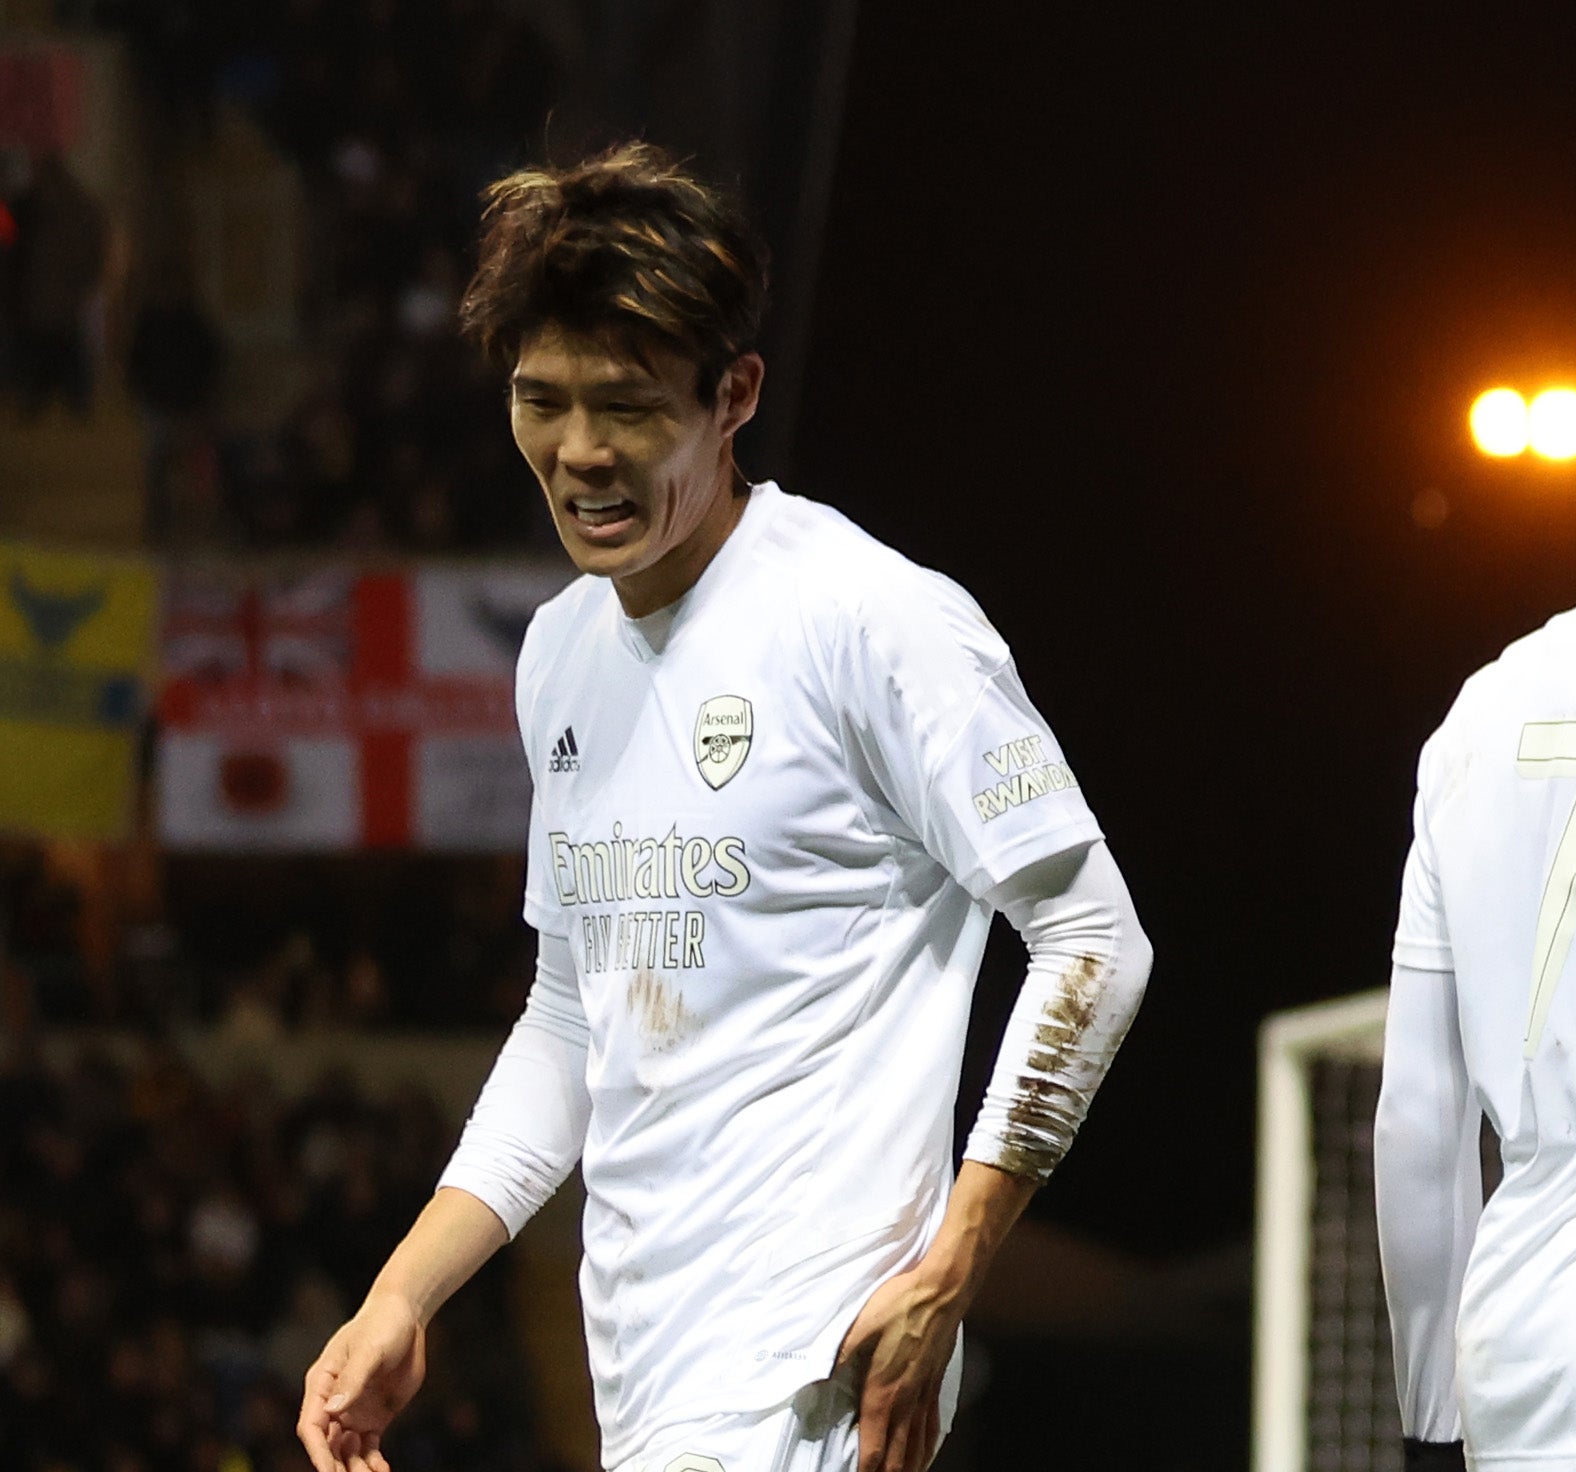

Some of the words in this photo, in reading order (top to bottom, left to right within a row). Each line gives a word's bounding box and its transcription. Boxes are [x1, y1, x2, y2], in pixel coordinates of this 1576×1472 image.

[703, 711, 745, 727] Arsenal
[983, 733, 1046, 776] VISIT
[972, 762, 1080, 824] RWANDA
[548, 820, 752, 907] Emirates
[582, 914, 612, 974] FLY
[615, 910, 707, 972] BETTER
